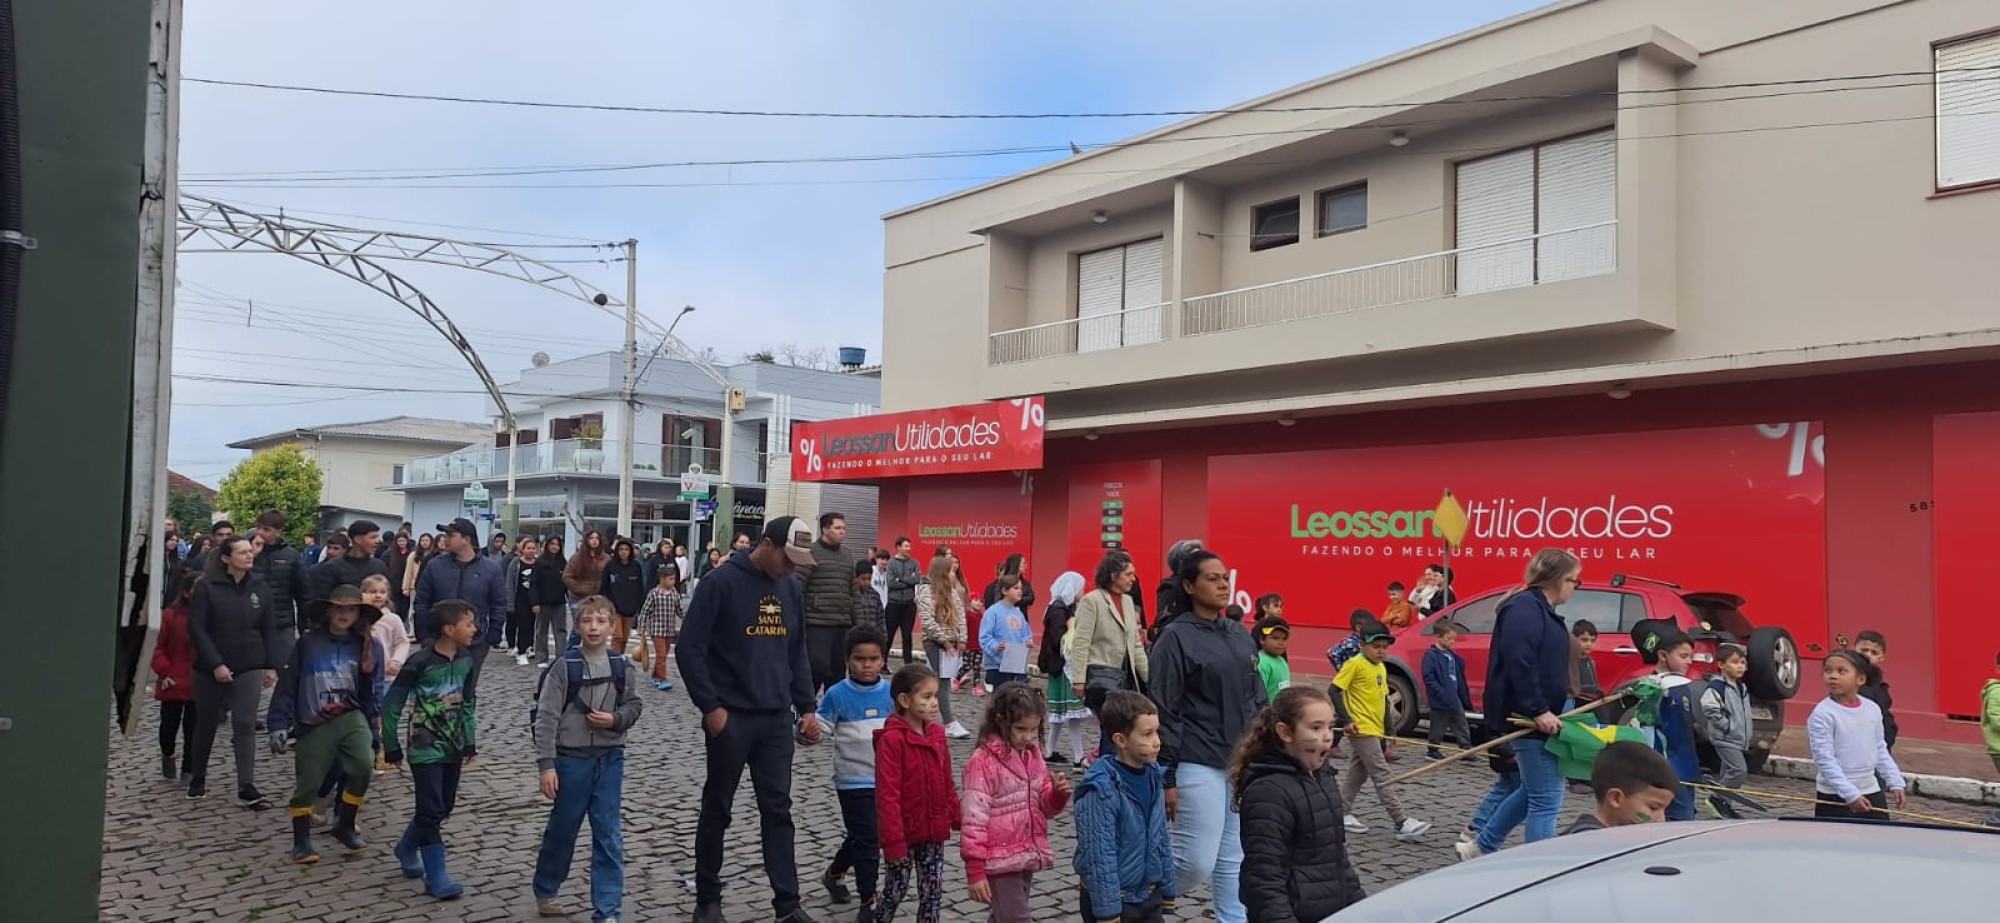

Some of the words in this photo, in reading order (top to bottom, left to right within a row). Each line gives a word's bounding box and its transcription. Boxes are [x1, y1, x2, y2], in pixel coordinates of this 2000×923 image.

[827, 459, 864, 469] FAZENDO
[866, 459, 873, 468] O
[875, 457, 911, 467] MELHOR
[914, 455, 937, 465] PARA
[940, 454, 947, 463] O
[952, 453, 969, 462] SEU
[973, 451, 992, 460] LAR
[1302, 545, 1374, 557] FAZENDO
[1383, 546, 1393, 557] O
[1485, 547, 1532, 558] PARA
[1616, 548, 1656, 559] LAR
[746, 626, 787, 636] CATARIN
